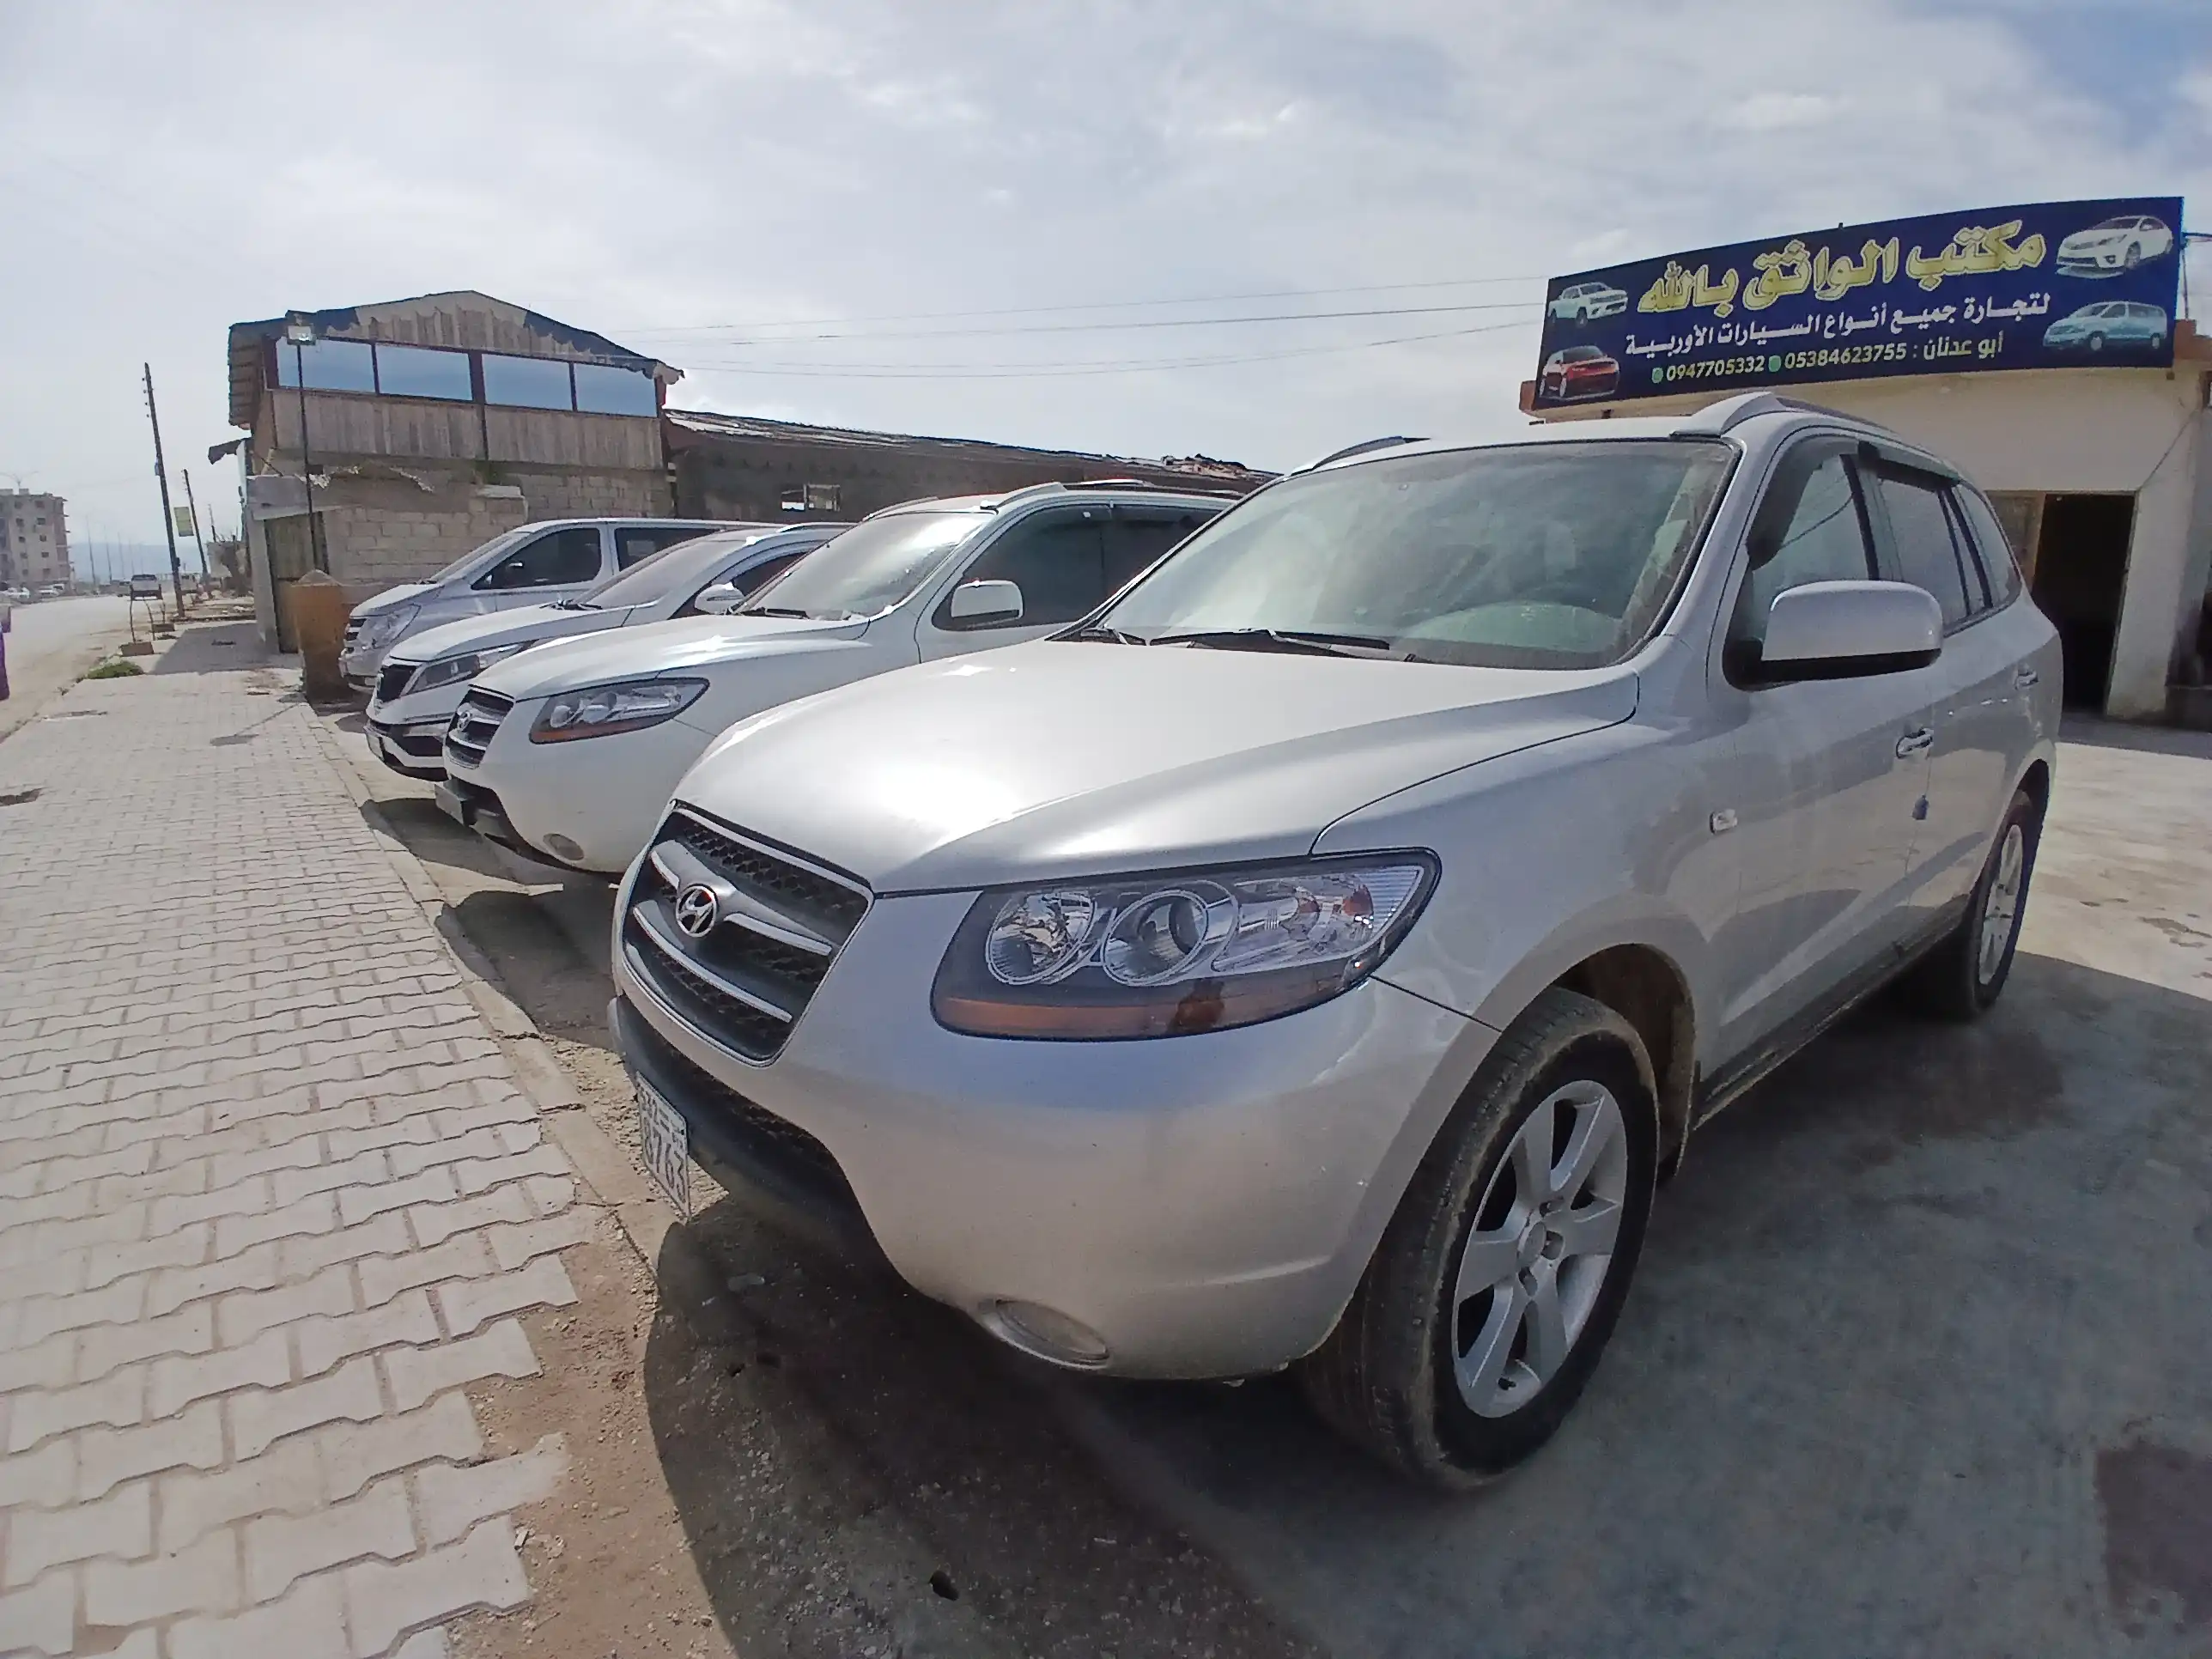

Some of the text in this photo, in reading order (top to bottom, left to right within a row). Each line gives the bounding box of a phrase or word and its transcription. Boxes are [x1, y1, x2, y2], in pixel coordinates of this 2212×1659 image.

[1638, 220, 2046, 318] مكتب الواثق بالله
[1823, 302, 1887, 338] أنواع
[1890, 304, 1957, 334] جميع
[1964, 293, 2051, 324] لتجارة
[1717, 313, 1820, 345] السيارات
[1784, 343, 1907, 369] 05384623755
[1923, 337, 1972, 361] عدنان
[1978, 330, 2004, 360] أبو
[1666, 356, 1765, 381] 0947705332
